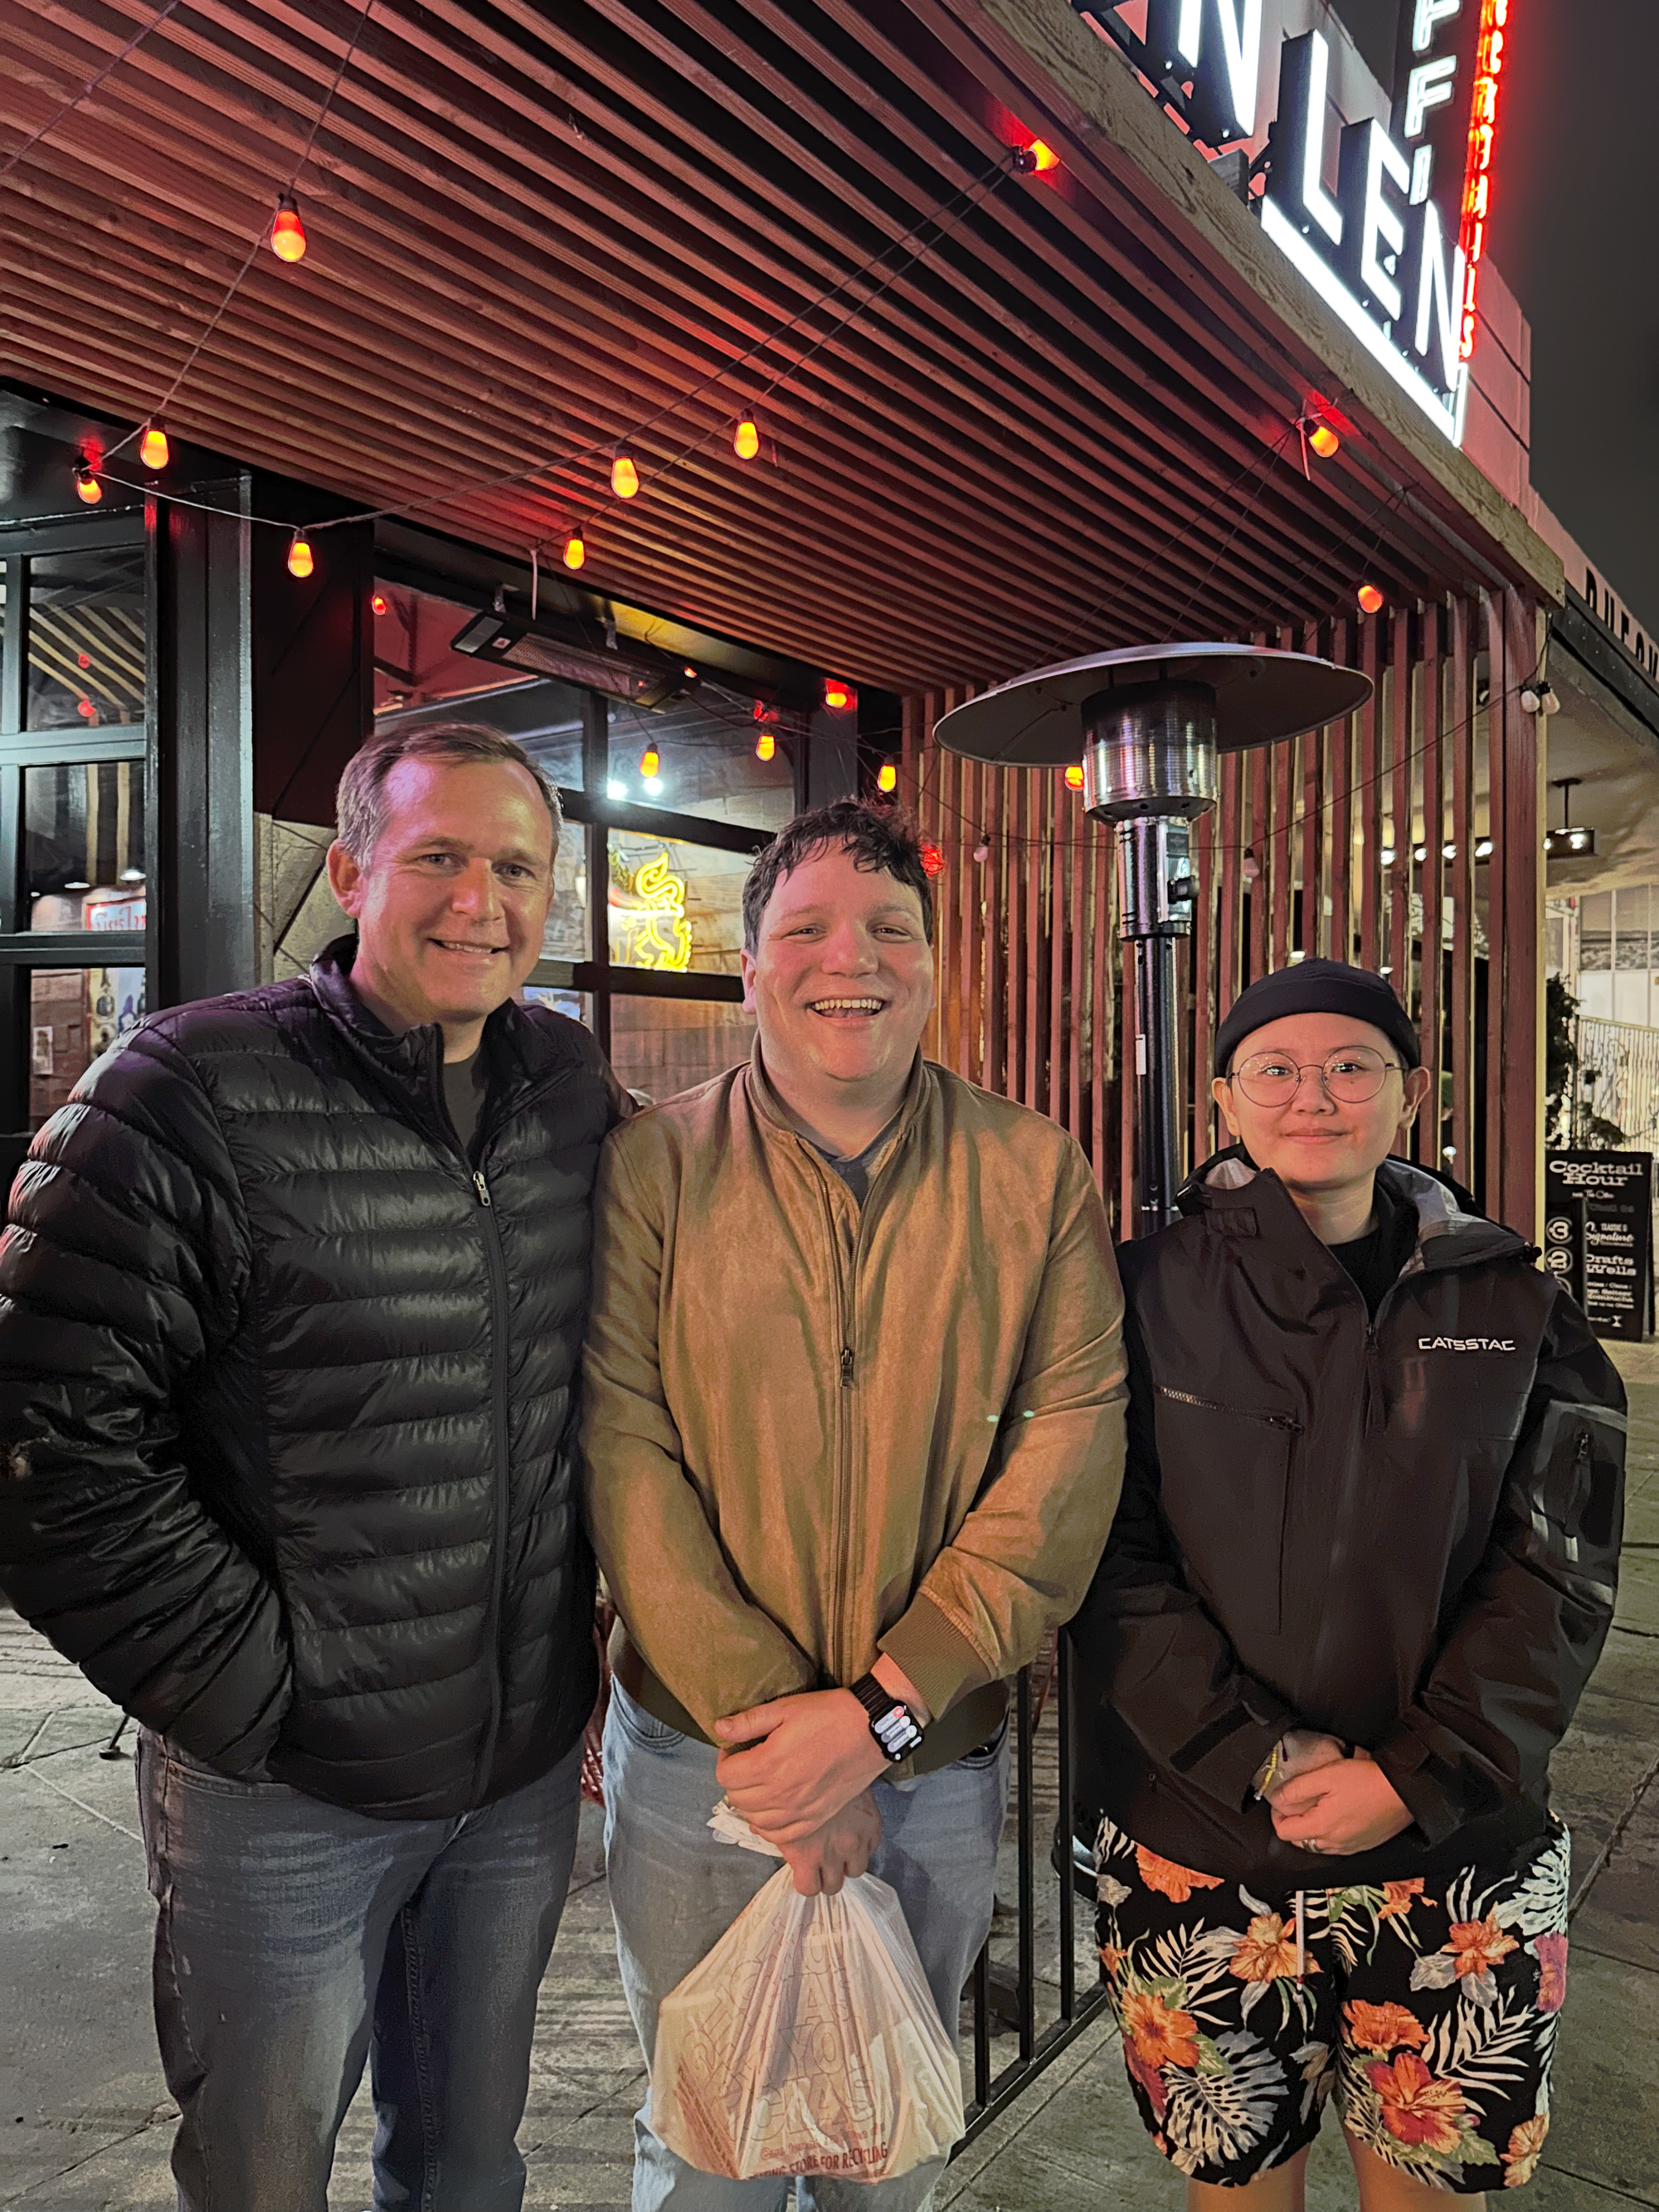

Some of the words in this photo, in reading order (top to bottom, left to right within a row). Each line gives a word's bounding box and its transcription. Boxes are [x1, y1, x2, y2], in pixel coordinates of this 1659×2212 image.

[1302, 30, 1466, 392] LEN
[1549, 1159, 1644, 1176] Cocktail
[1562, 1173, 1628, 1187] Hour
[1585, 1264, 1637, 1276] Wells
[789, 2155, 820, 2175] STORE
[820, 2155, 839, 2170] FOR
